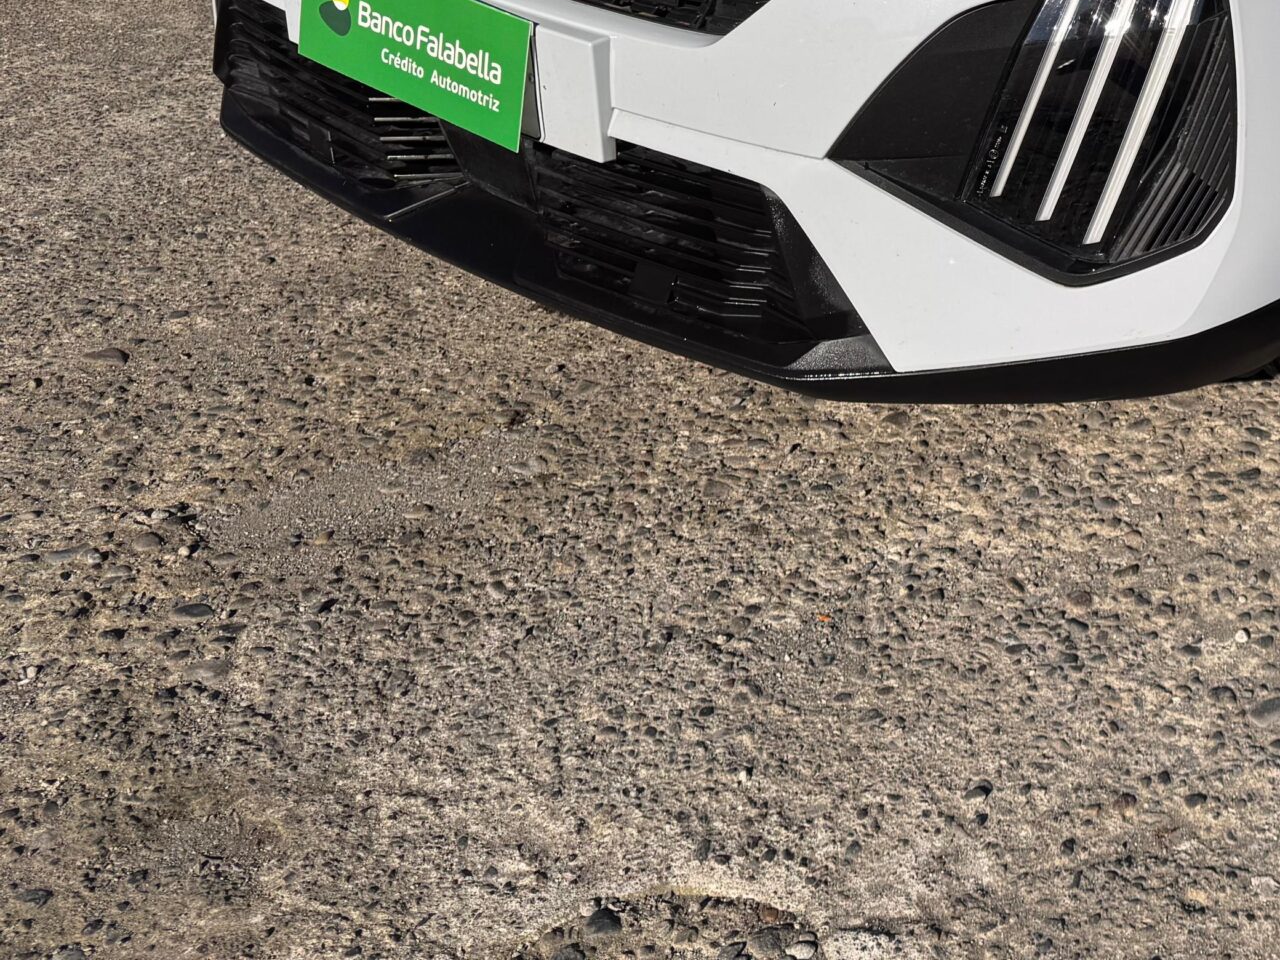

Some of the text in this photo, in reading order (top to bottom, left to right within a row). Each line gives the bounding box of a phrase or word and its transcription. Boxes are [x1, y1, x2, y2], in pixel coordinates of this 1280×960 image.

[357, 0, 502, 85] Banco Falabella
[380, 47, 500, 113] Crédito Automotriz
